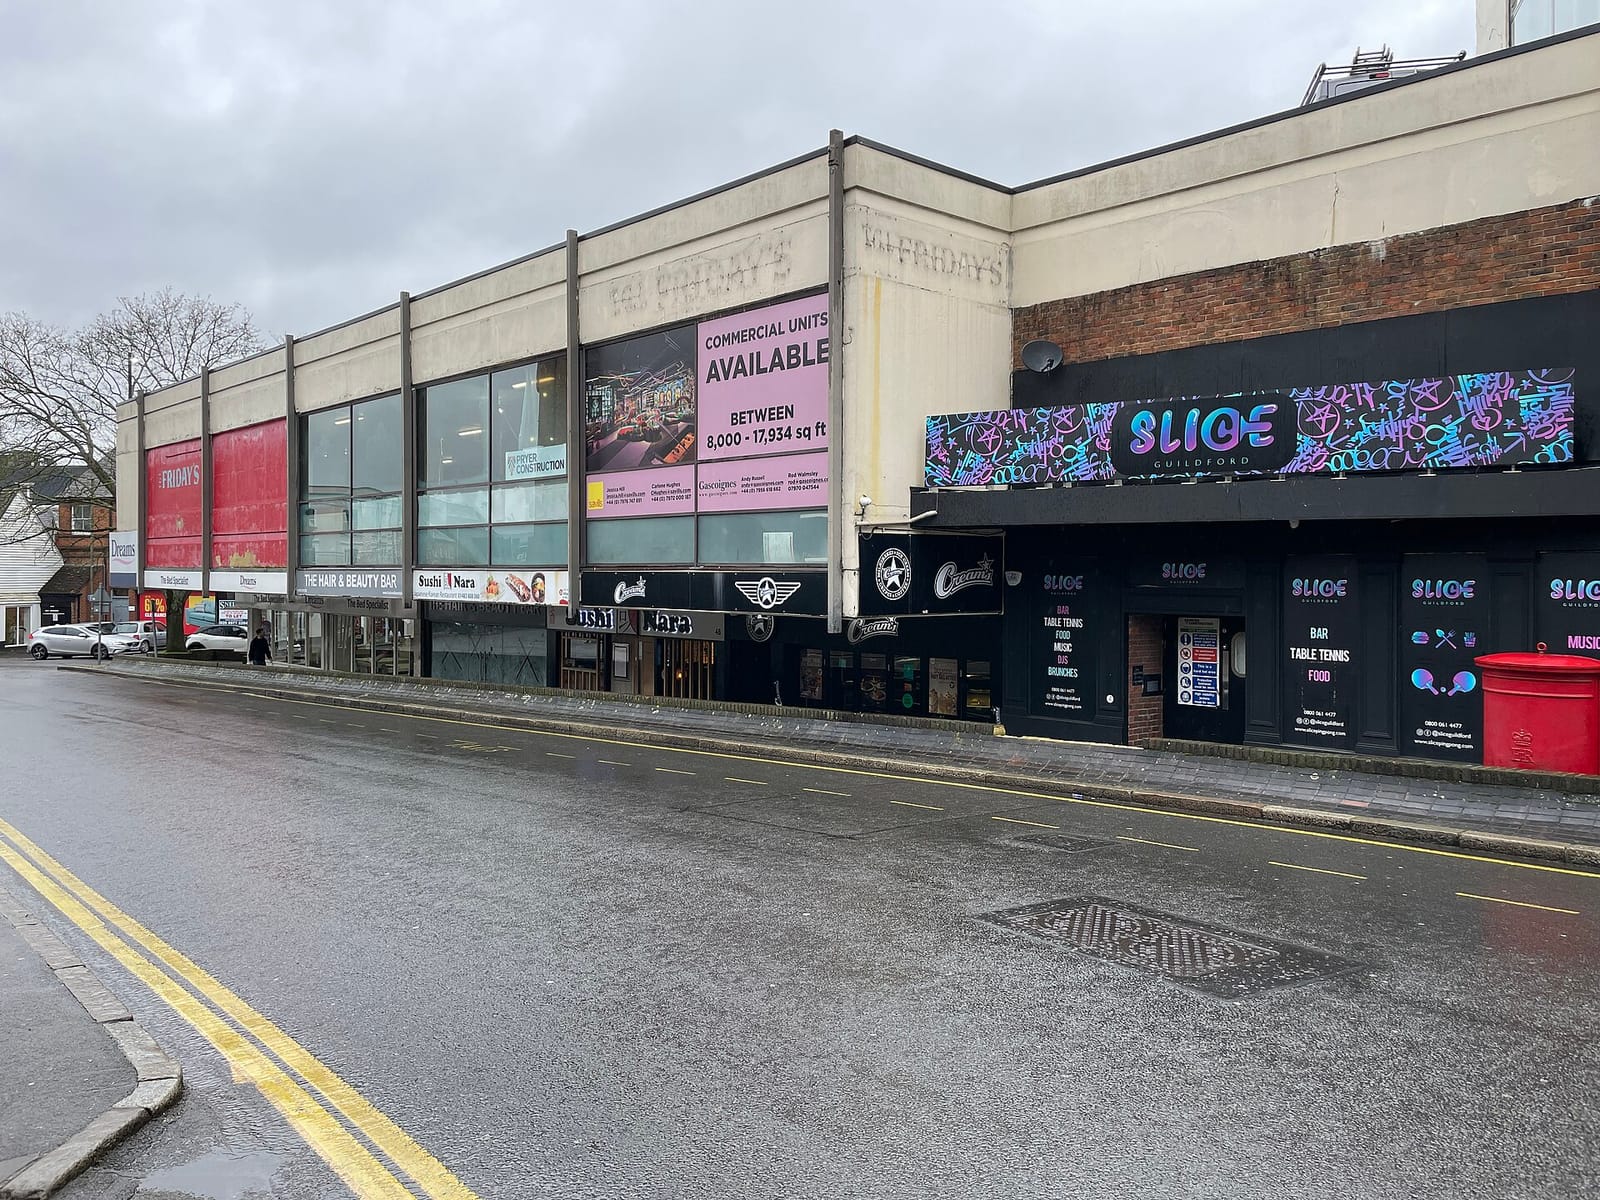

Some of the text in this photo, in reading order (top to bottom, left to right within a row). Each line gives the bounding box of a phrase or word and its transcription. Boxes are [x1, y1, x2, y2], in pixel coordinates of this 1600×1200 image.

[705, 312, 828, 350] COMMERCIAL UNITS
[705, 338, 829, 383] AVAILABLE
[730, 404, 794, 426] BETWEEN
[707, 433, 742, 450] 8,000
[752, 426, 792, 445] 17,934
[796, 427, 811, 441] sq
[814, 421, 826, 436] ft
[1129, 404, 1279, 455] SLICE
[516, 453, 538, 464] PRYER
[1154, 456, 1249, 468] GUILDFORD
[516, 459, 565, 474] CONSTRUCTION
[162, 463, 200, 489] FRIDAY'S
[698, 479, 737, 491] Gascoignes
[111, 539, 135, 558] Dreams
[239, 575, 257, 586] Dreams
[304, 574, 398, 589] THE HAIR & BEAUTY BAR
[418, 574, 442, 588] Sushi
[453, 575, 476, 589] Nara
[934, 560, 994, 600] Cream's
[1291, 578, 1348, 598] SLICE
[1411, 578, 1476, 599] SLICE
[356, 599, 366, 609] Bed
[366, 599, 389, 611] Specialist
[1056, 605, 1070, 615] BAR
[577, 608, 614, 629] ushi
[643, 609, 693, 634] Nara
[1043, 616, 1084, 628] TABLE TENNIS
[1055, 630, 1071, 640] FOOD
[1310, 627, 1329, 640] BAR
[1053, 642, 1073, 652] MUSIC
[1567, 635, 1600, 650] MUSIC
[1057, 655, 1068, 664] DJS
[1290, 647, 1350, 663] TABLE TENNIS
[1047, 666, 1079, 678] BRUNCHES
[1308, 669, 1331, 682] FOOD
